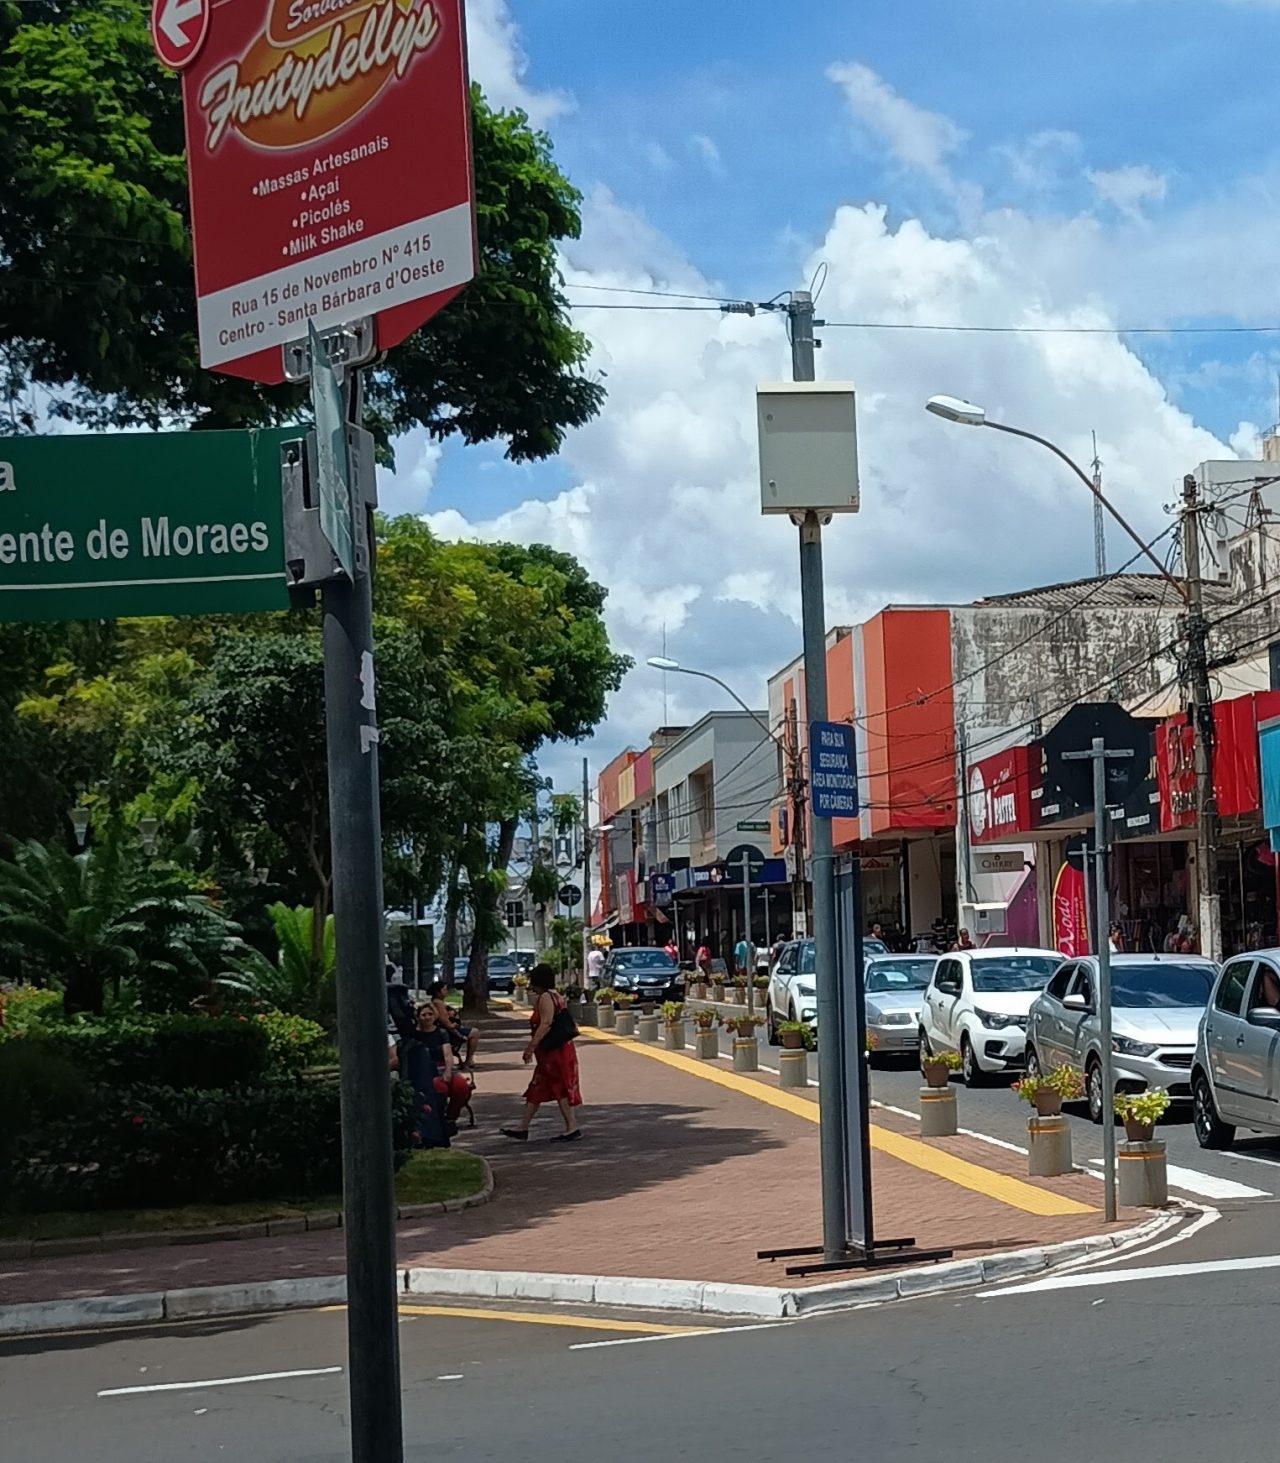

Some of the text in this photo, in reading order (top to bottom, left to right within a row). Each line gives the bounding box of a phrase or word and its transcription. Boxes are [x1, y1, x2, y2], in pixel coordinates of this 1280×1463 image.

[201, 3, 438, 149] Frutydellys
[259, 135, 389, 197] Massas Artesanais
[290, 218, 364, 257] Milk Shake
[300, 199, 350, 228] Picolés
[219, 320, 265, 347] Centro
[277, 300, 318, 327] Santa
[322, 277, 381, 313] Bárbara
[385, 257, 445, 289] d'Oeste
[232, 296, 259, 318] Rua
[262, 287, 279, 308] 15
[282, 280, 300, 299] de
[304, 256, 377, 293] Novembro
[404, 235, 431, 257] 415
[87, 519, 129, 559] de
[141, 517, 269, 557] Moraes
[821, 731, 845, 748] PARA SUA
